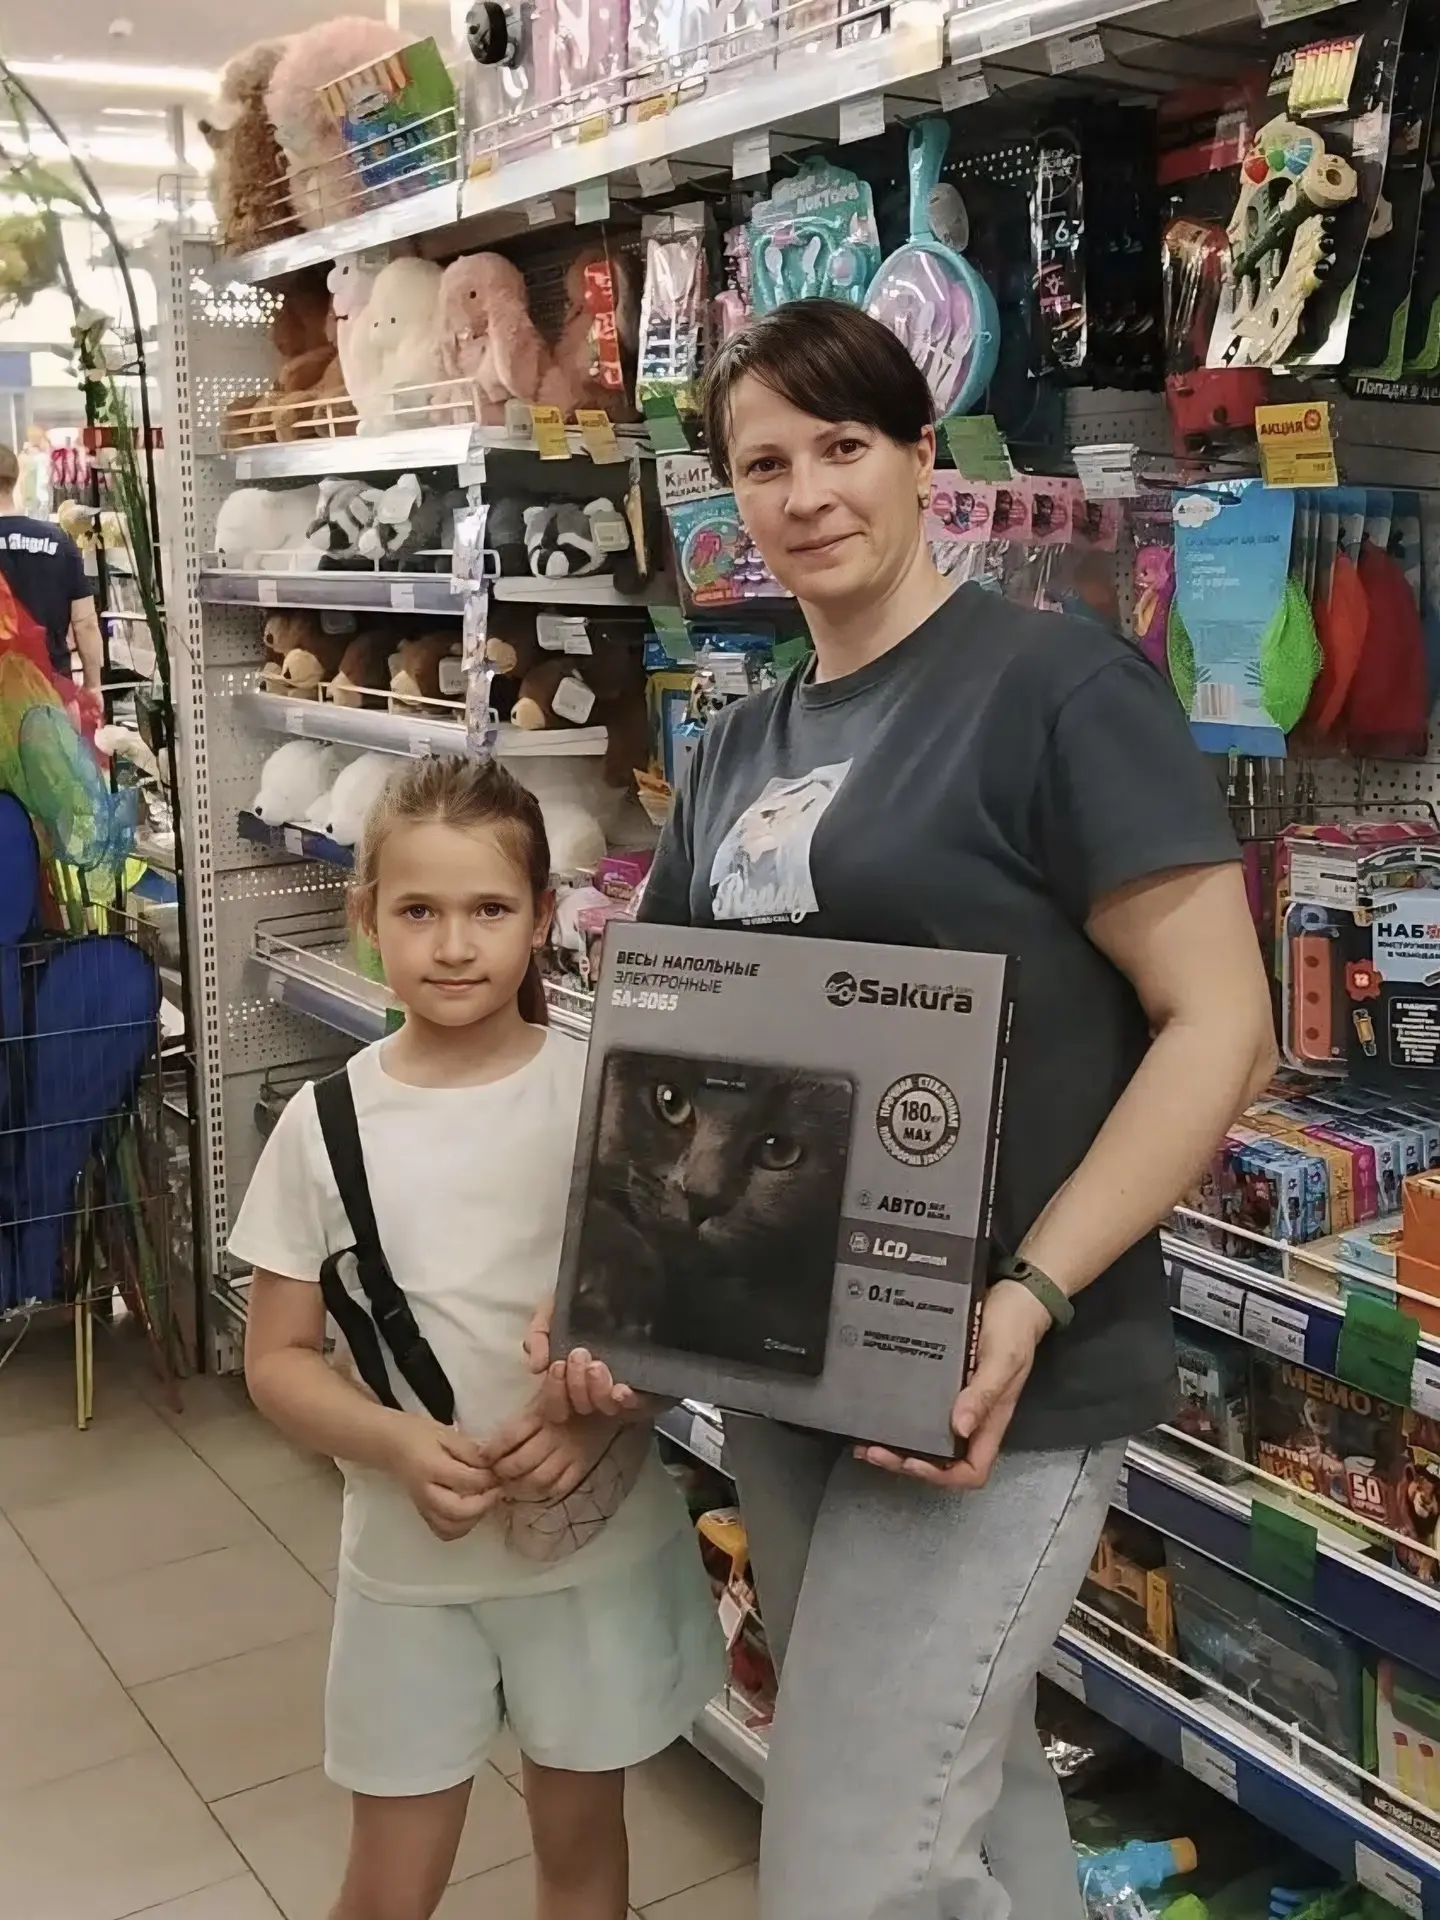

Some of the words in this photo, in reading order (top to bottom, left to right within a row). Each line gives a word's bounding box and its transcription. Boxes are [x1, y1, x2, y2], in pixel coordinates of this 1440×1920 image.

[1261, 421, 1303, 436] АКЦИЯ
[665, 467, 710, 487] КНИГ
[616, 951, 658, 968] ВЕСЫ
[663, 955, 760, 977] НАПОЛЬНЫЕ
[613, 970, 723, 994] ЭЛЕКТРОННЫЕ
[858, 978, 973, 1014] Sakura
[900, 1100, 931, 1123] 180
[902, 1127, 932, 1141] MAX
[877, 1195, 927, 1217] АВТО
[872, 1237, 908, 1259] LCD
[868, 1284, 893, 1304] 0.1
[1352, 1474, 1381, 1504] 50
